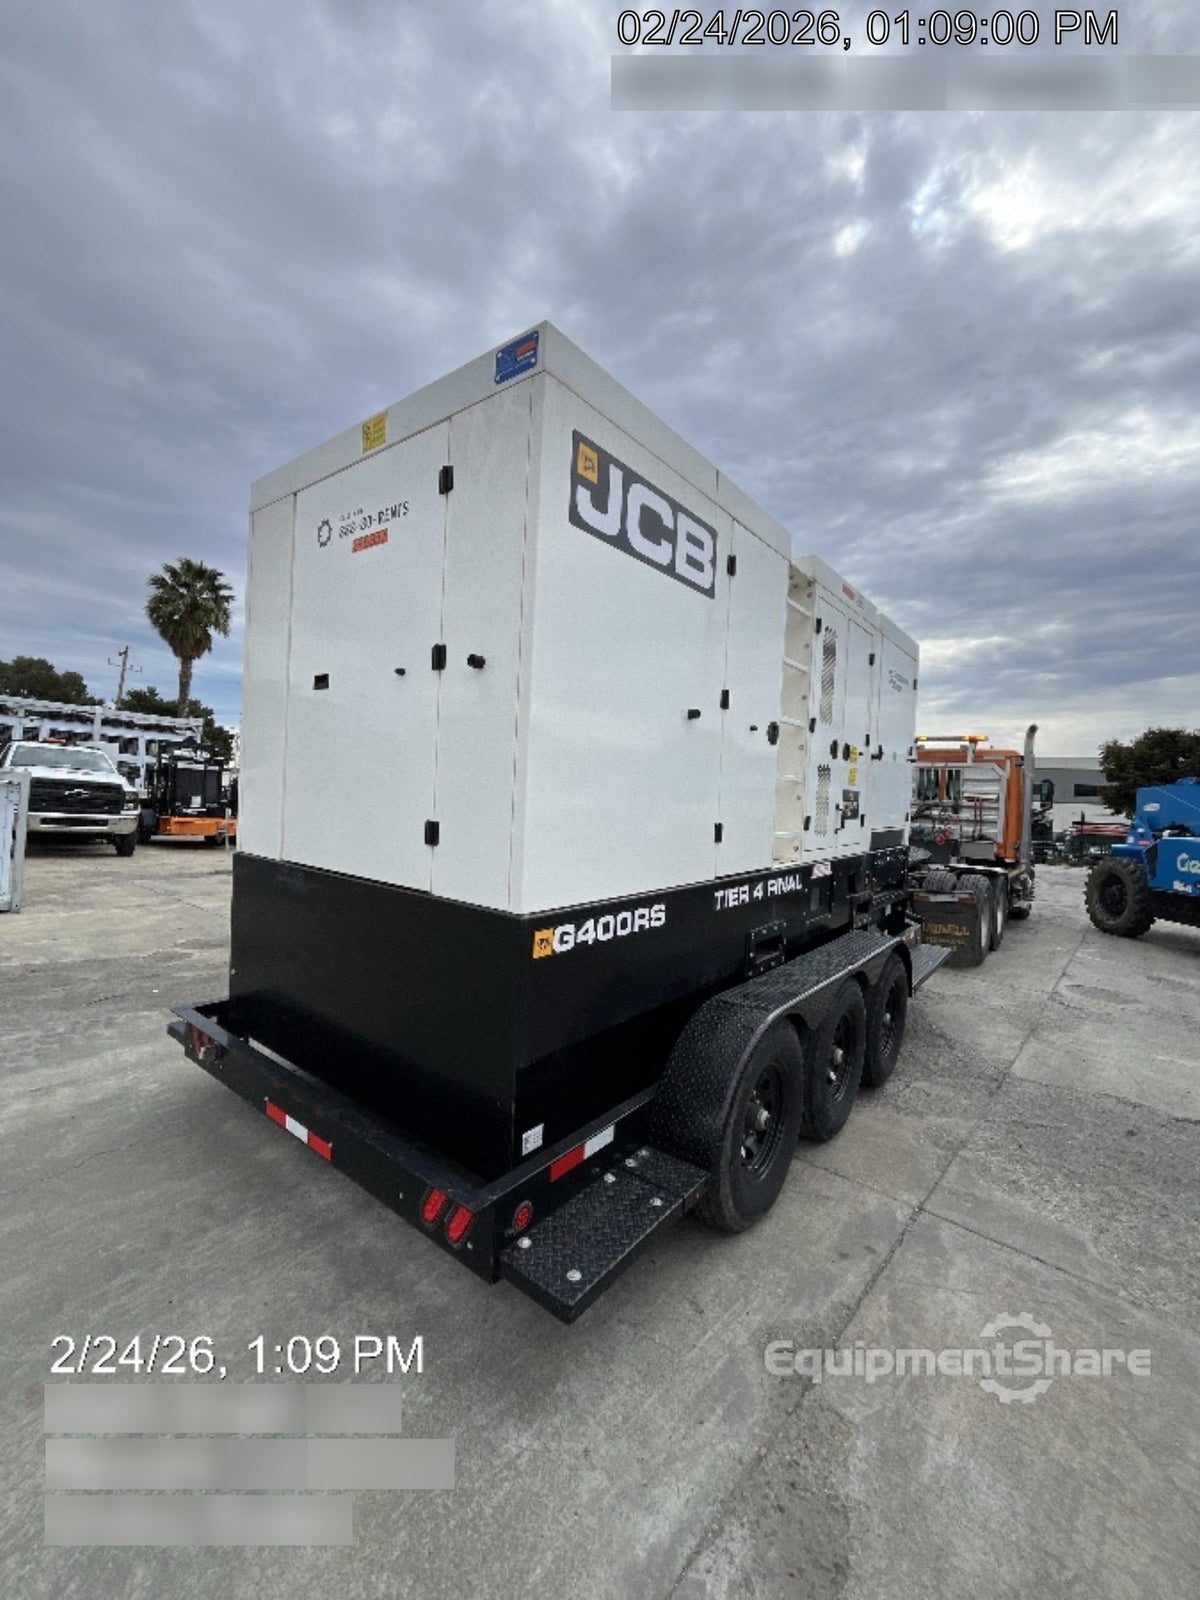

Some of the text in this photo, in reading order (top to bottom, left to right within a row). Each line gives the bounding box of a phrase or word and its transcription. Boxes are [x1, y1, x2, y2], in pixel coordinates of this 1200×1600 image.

[575, 463, 715, 590] JCB
[714, 884, 750, 911] TIER
[753, 882, 764, 900] 4
[552, 902, 666, 954] G400RS
